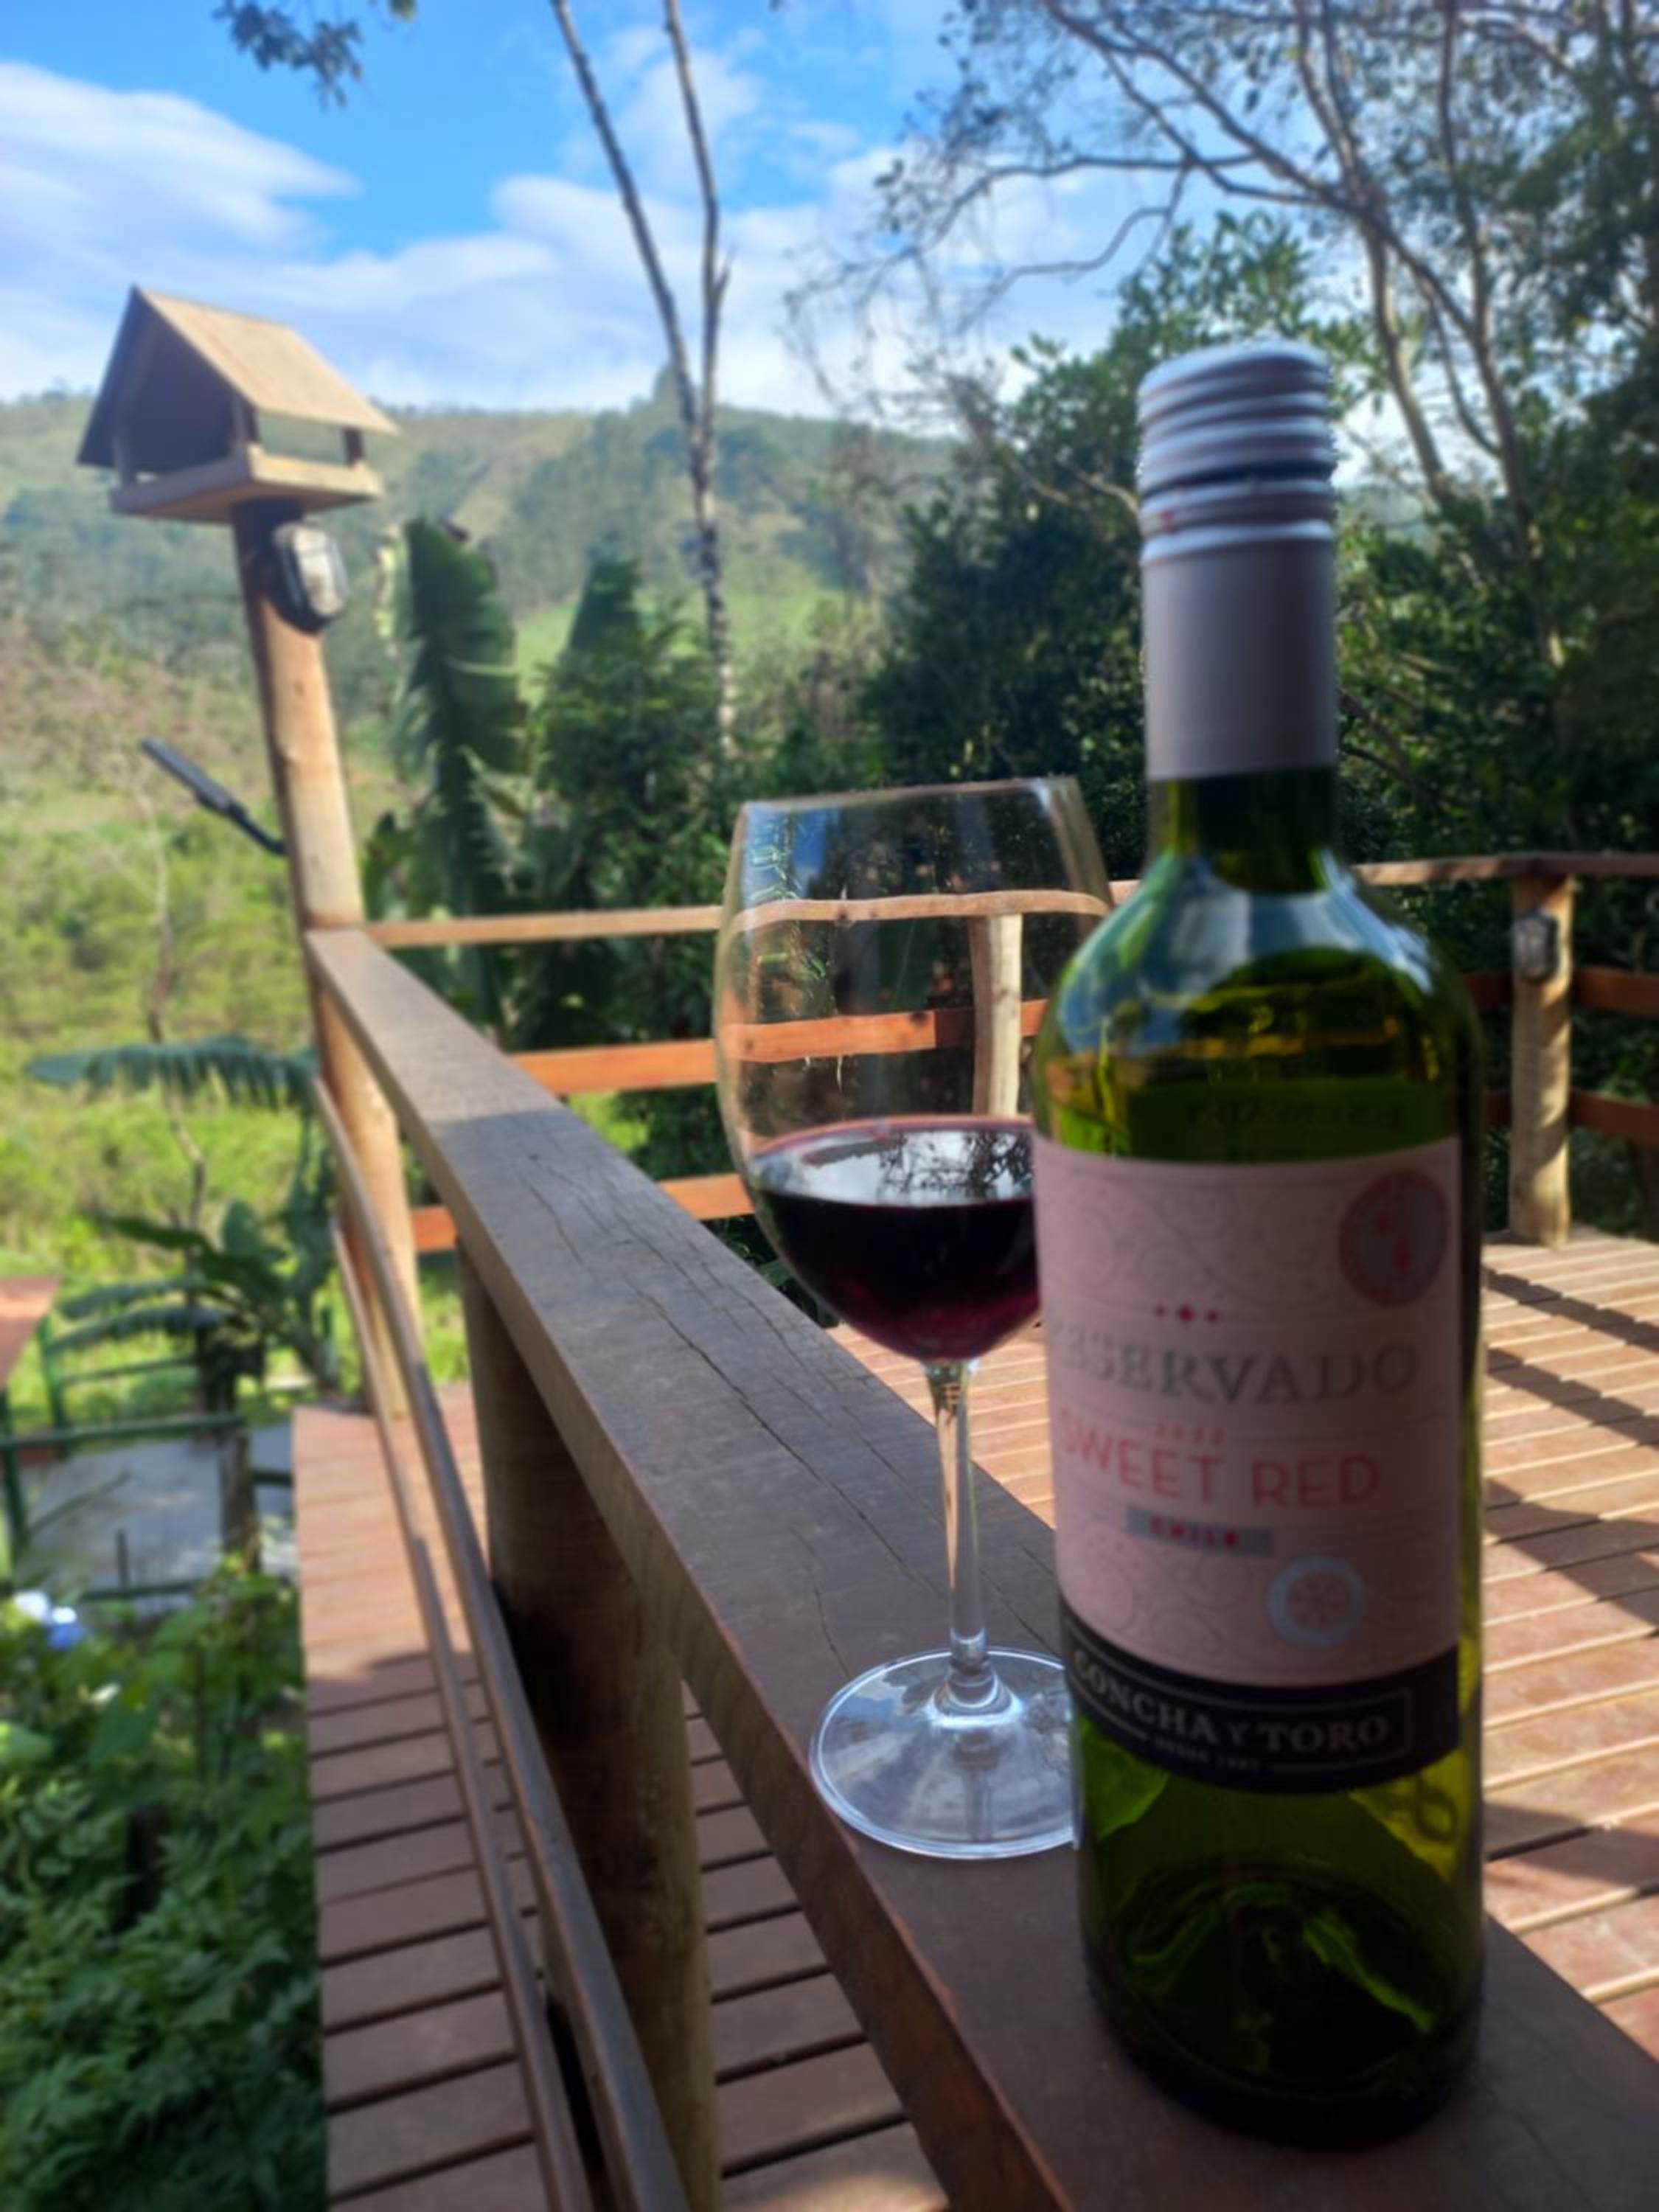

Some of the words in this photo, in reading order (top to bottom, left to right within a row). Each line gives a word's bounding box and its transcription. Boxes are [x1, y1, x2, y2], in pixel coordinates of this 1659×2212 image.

[1060, 1408, 1223, 1506] SWEET
[1251, 1453, 1382, 1509] RED
[1074, 1649, 1218, 1745] CONCHA
[1228, 1723, 1252, 1747] Y
[1260, 1714, 1389, 1753] TORO
